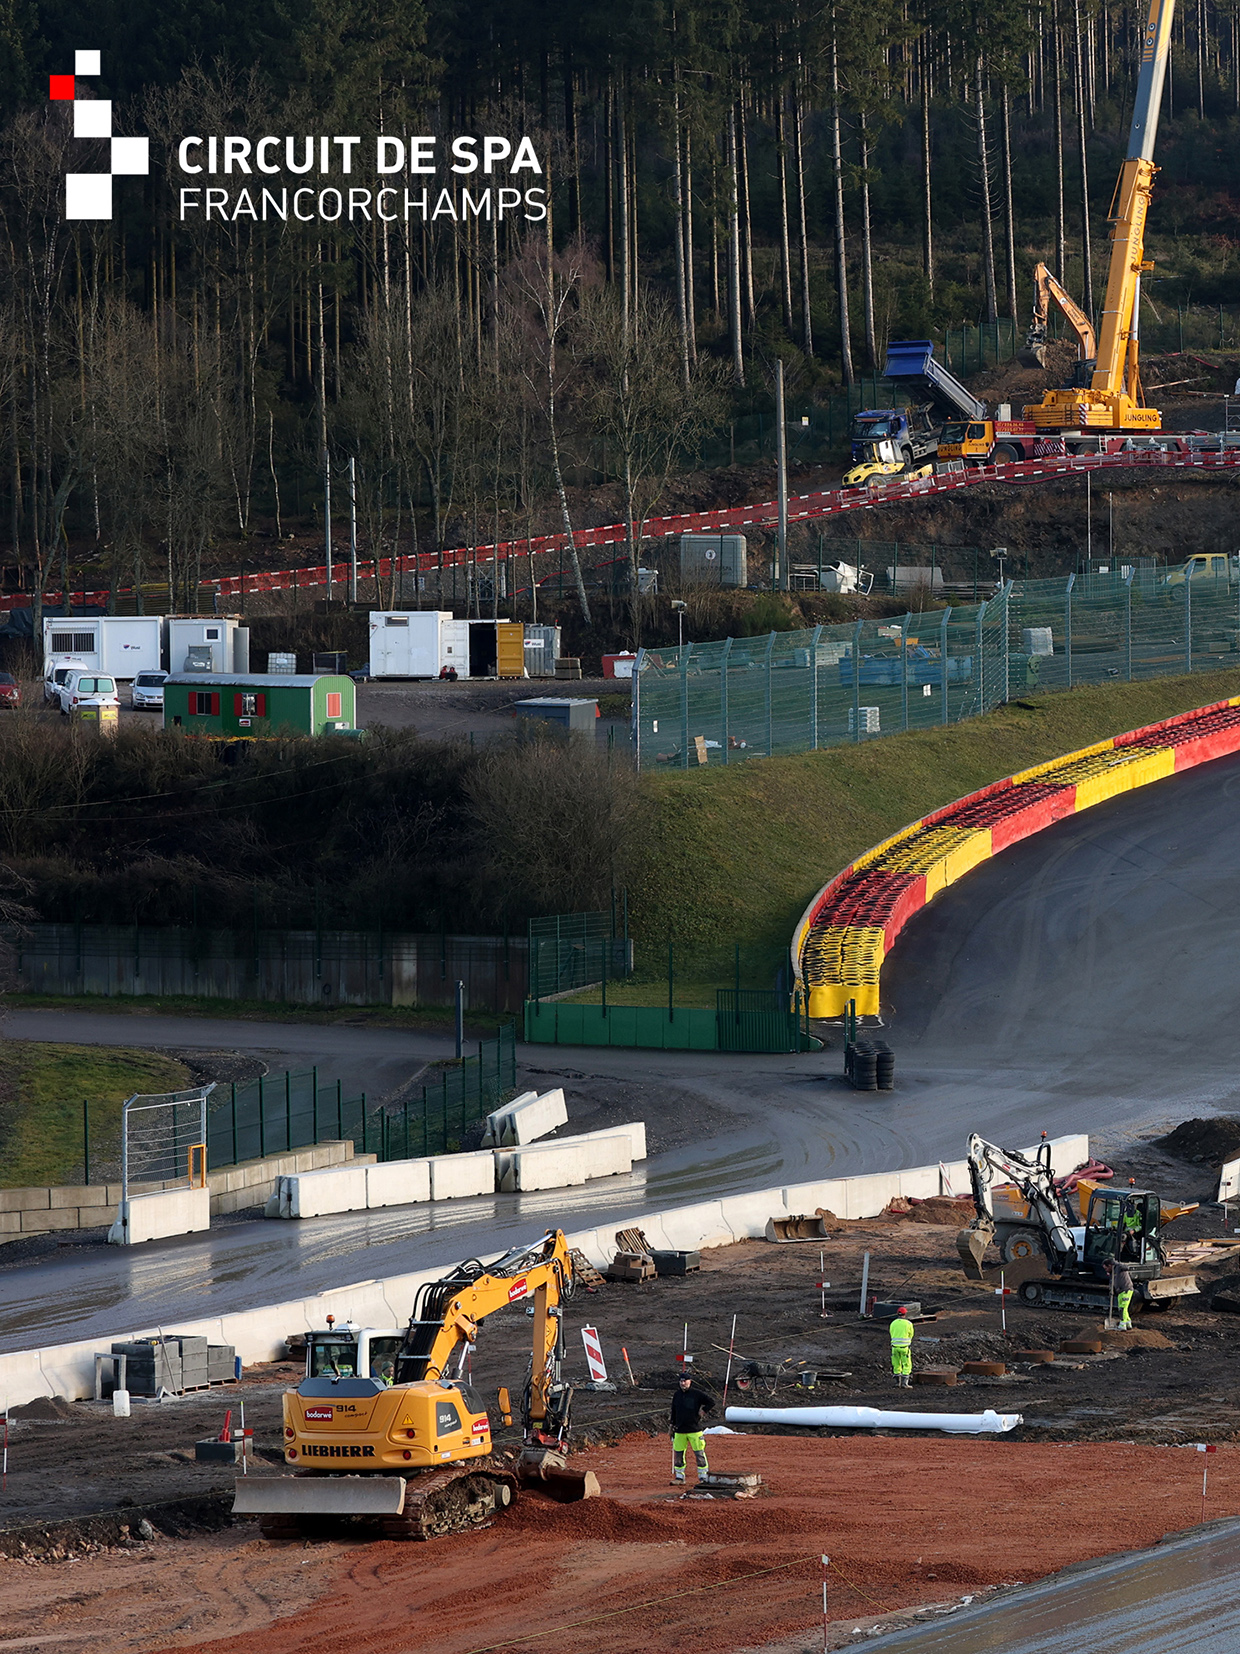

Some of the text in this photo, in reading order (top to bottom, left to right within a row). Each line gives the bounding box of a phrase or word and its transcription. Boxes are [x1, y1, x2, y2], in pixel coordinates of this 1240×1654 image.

[1130, 197, 1146, 262] JUNGLING
[1124, 414, 1158, 423] JUNGLING
[336, 1404, 356, 1413] 914
[306, 1410, 333, 1419] bodarwé
[439, 1413, 452, 1424] 914
[301, 1444, 377, 1458] LIEBHERR
